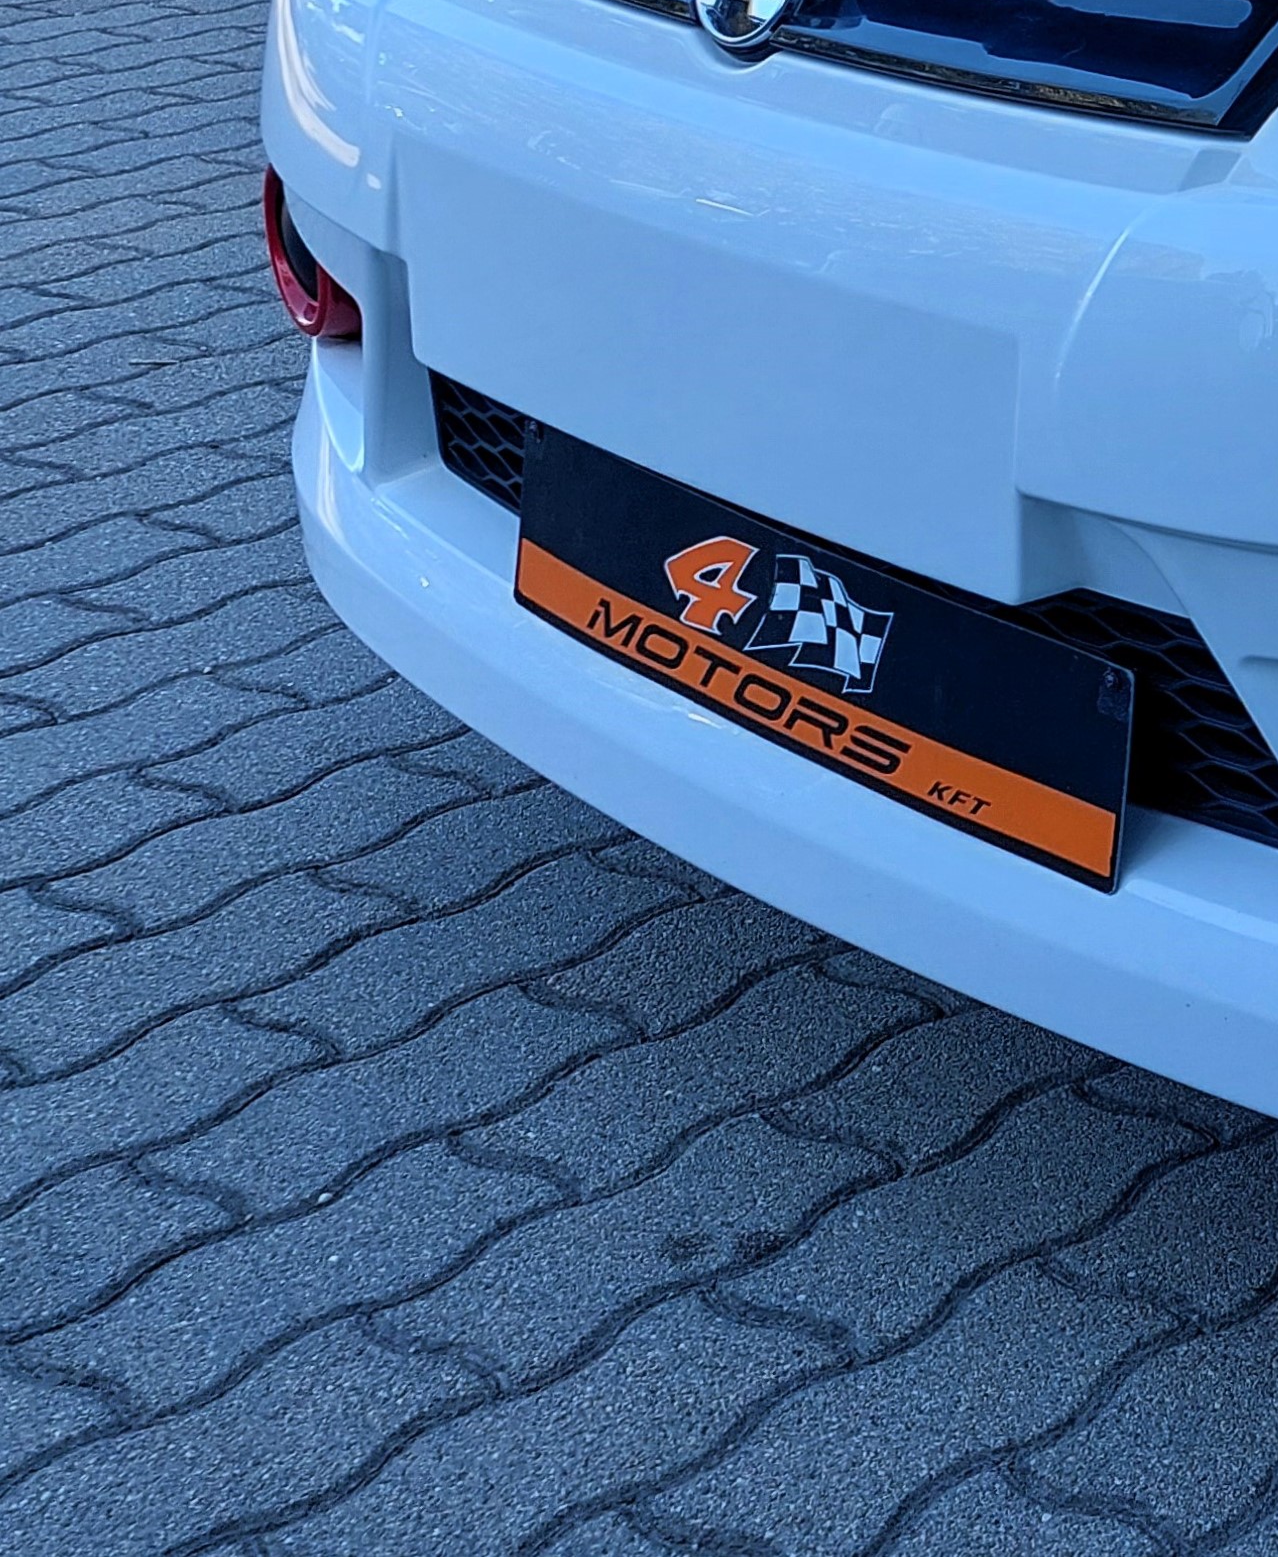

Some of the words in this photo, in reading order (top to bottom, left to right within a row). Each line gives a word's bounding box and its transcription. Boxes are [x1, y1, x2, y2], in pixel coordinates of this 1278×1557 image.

[663, 535, 760, 634] 4
[586, 598, 911, 777] MOTORS
[927, 780, 992, 816] KFT
